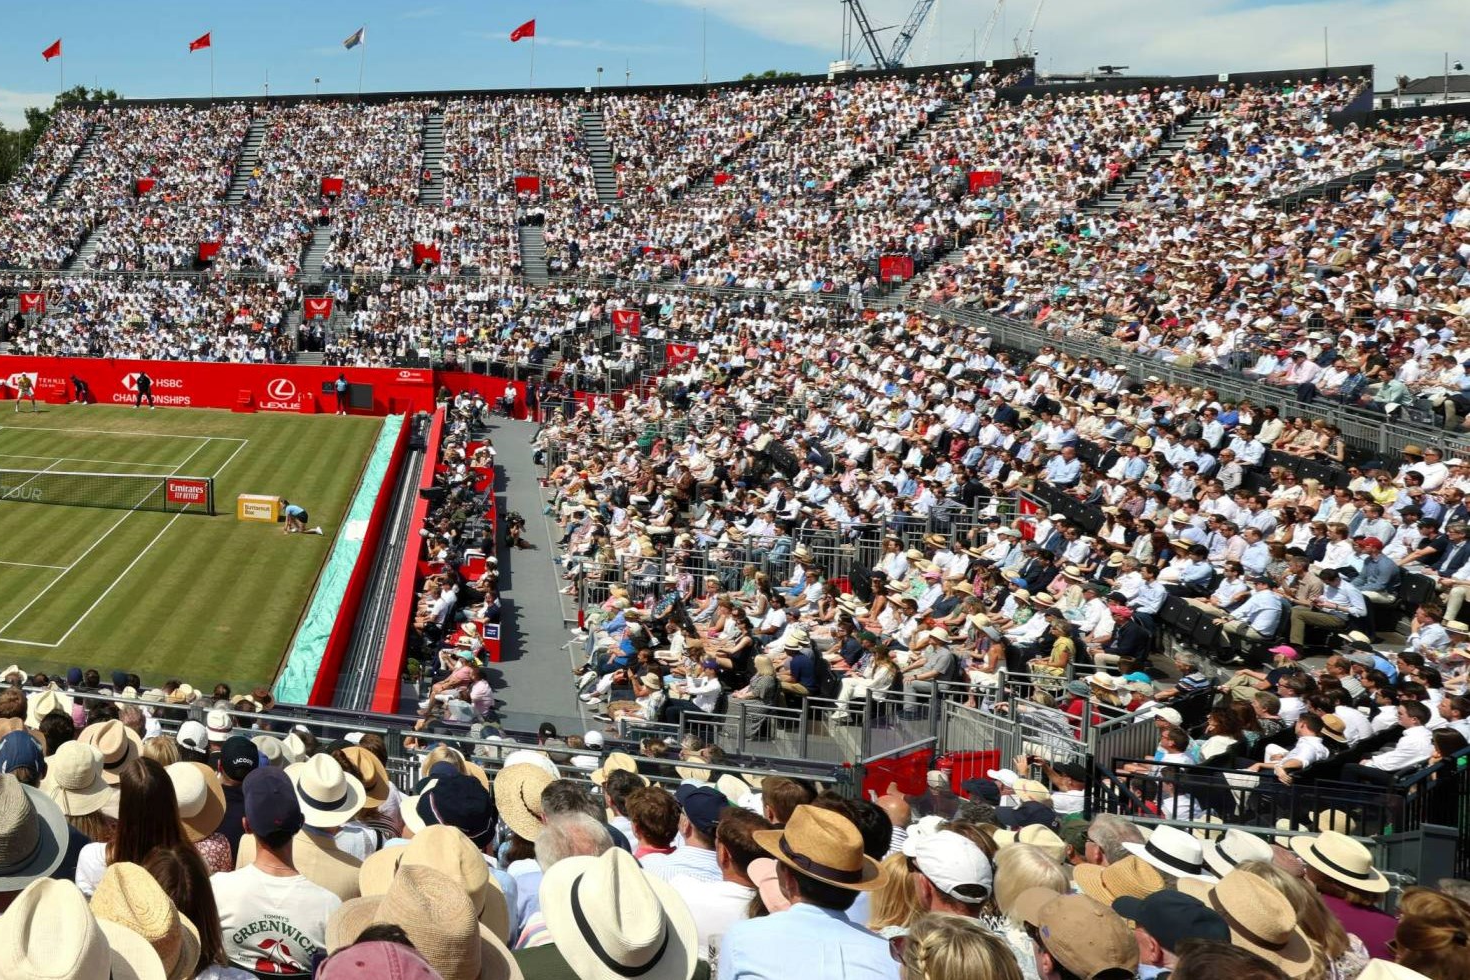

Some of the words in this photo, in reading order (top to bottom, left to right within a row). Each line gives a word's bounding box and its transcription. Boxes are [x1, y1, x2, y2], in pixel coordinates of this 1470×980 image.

[156, 378, 183, 388] HSBC
[113, 393, 191, 405] CHAMPONSHIPS
[0, 486, 43, 500] TOUR
[170, 483, 204, 494] Emirates
[232, 920, 317, 956] GREENWICH
